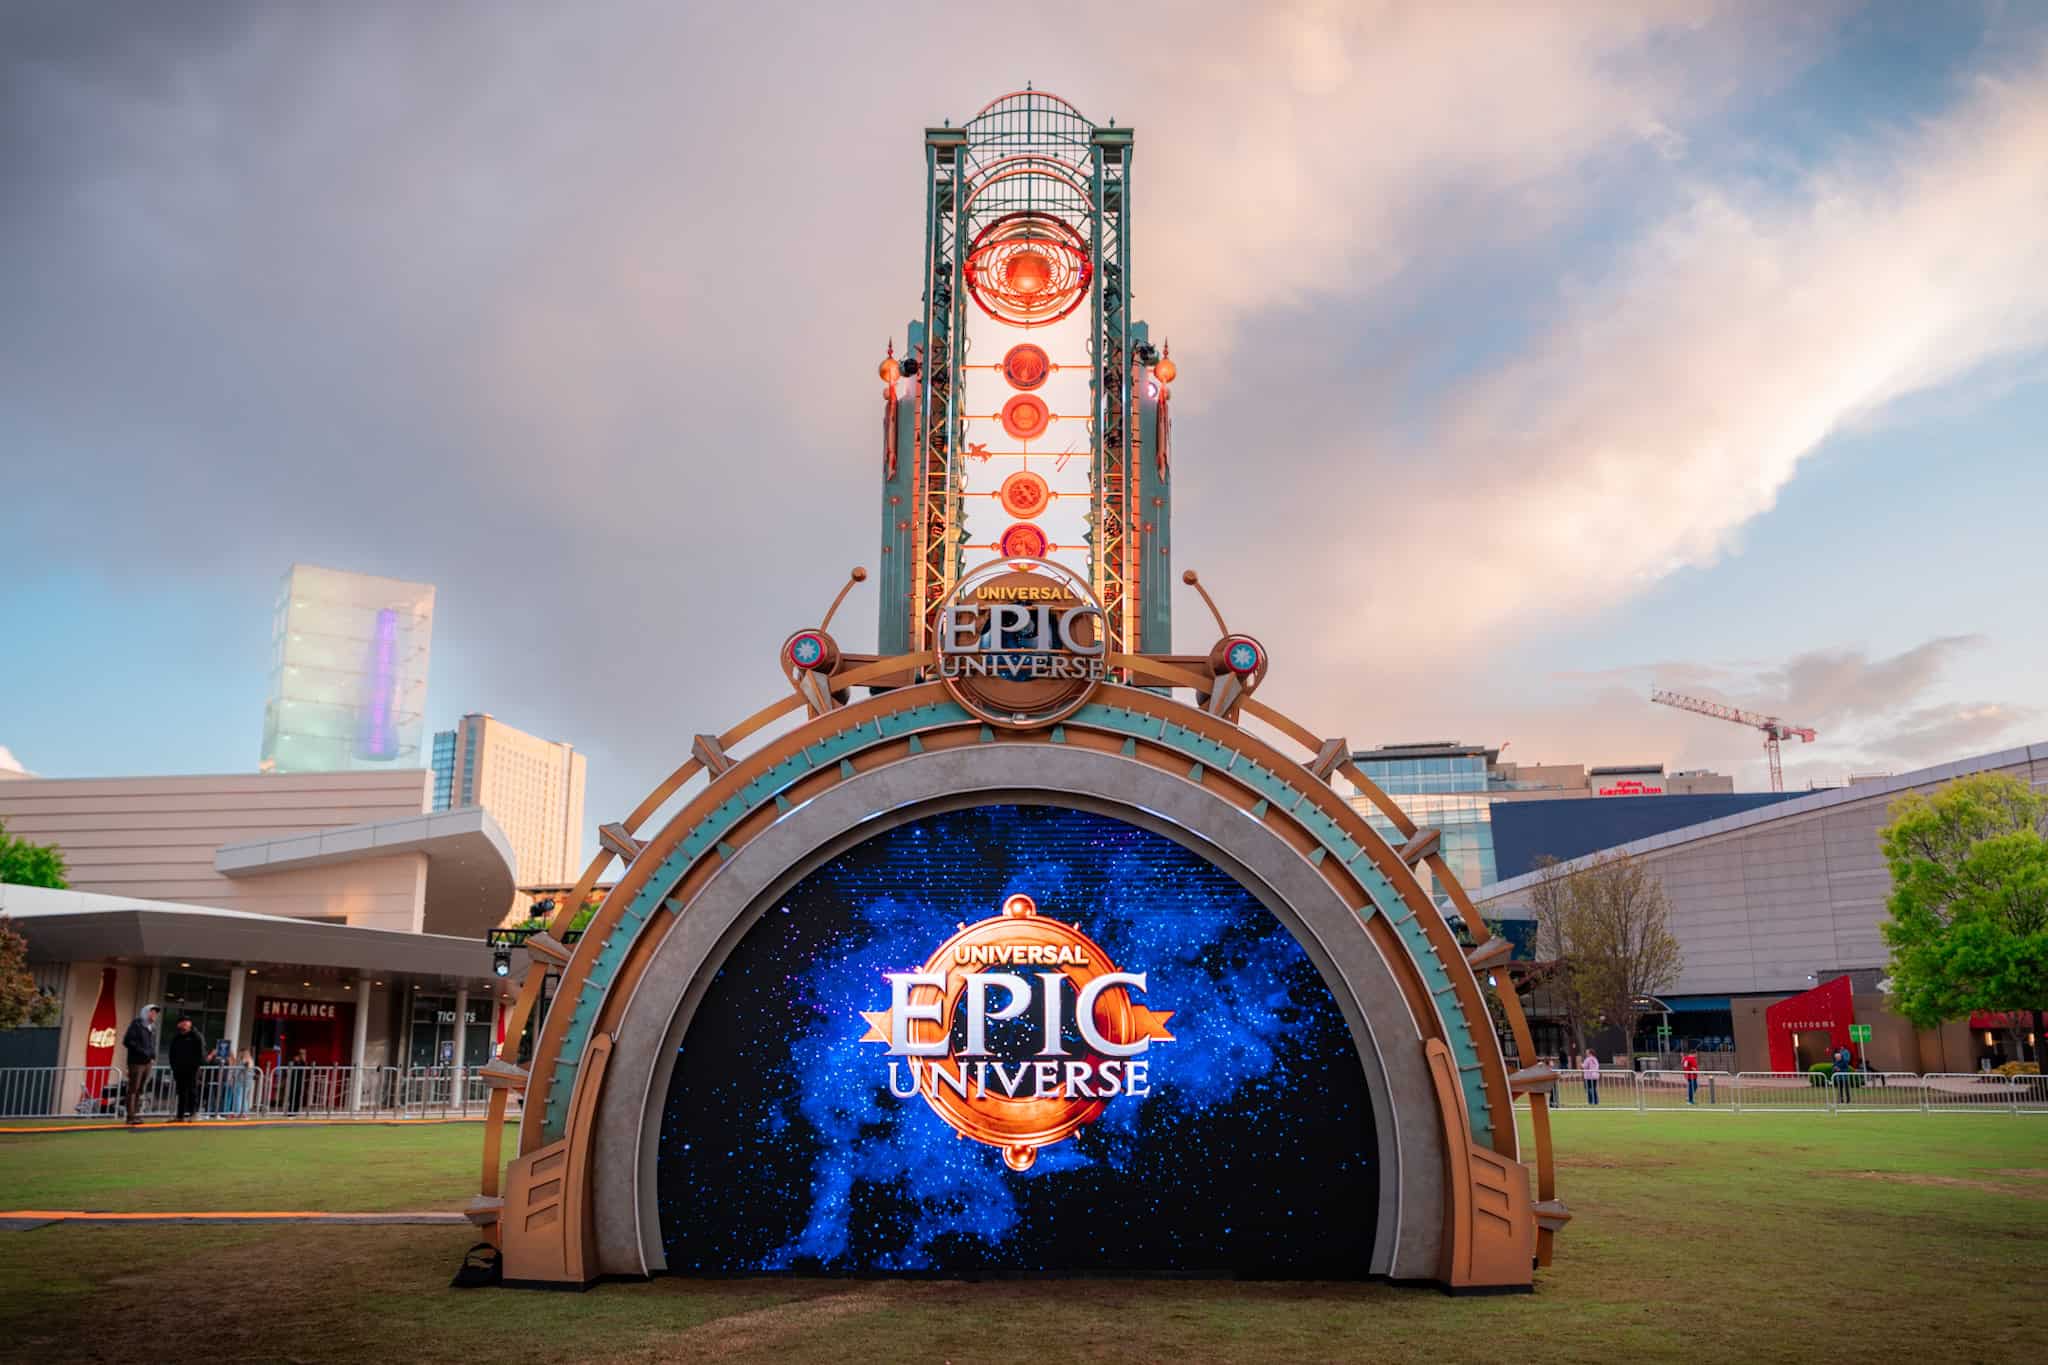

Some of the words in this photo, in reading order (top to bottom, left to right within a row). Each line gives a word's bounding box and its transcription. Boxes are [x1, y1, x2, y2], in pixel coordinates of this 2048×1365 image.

[976, 586, 1074, 600] UNIVERSAL
[943, 603, 1105, 655] EPIC
[940, 654, 1105, 681] UNIVERSE
[1642, 785, 1662, 795] Inn
[953, 945, 1090, 965] UNIVERSAL
[263, 1000, 335, 1018] ENTRANCE
[437, 1010, 477, 1023] TICTS
[881, 970, 1152, 1058] EPIC
[1782, 1021, 1835, 1029] restrooms
[887, 1060, 1151, 1098] UNIVERSE
